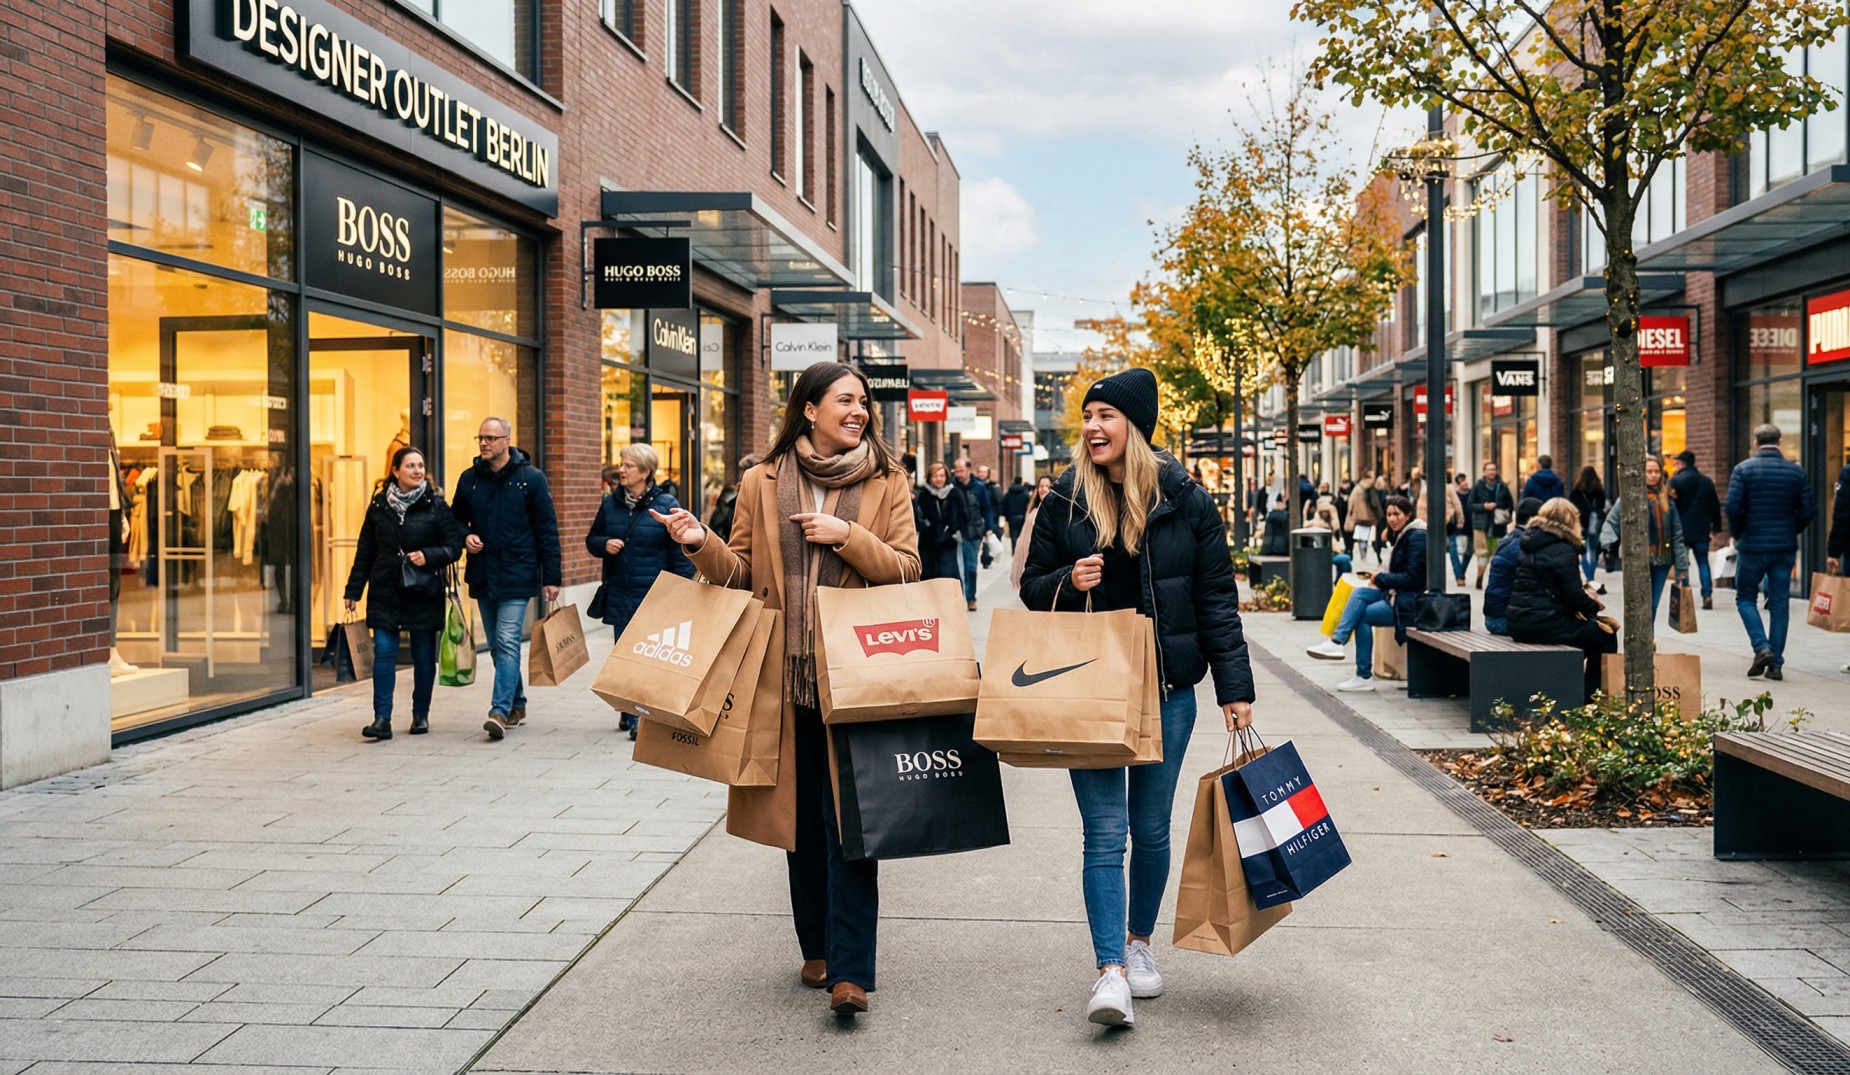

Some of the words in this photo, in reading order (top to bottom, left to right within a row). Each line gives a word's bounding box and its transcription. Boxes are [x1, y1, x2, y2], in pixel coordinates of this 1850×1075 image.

[233, 0, 388, 110] DESIGNER
[394, 69, 481, 153] OUTLET
[487, 117, 549, 188] BERLIN
[337, 196, 411, 263] BOSS
[338, 249, 372, 270] HUGO
[379, 261, 410, 281] BOSS
[604, 265, 644, 277] HUGO
[647, 265, 681, 277] BOSS
[1809, 305, 1850, 354] PUM
[775, 341, 807, 352] Calvin
[808, 341, 832, 352] Klein
[1496, 370, 1535, 386] VANS
[633, 641, 693, 667] adidas
[672, 731, 700, 746] FOSSIL
[894, 749, 962, 773] BOSS
[1261, 775, 1302, 805] TOMMY
[1286, 822, 1331, 856] HILFIGER
